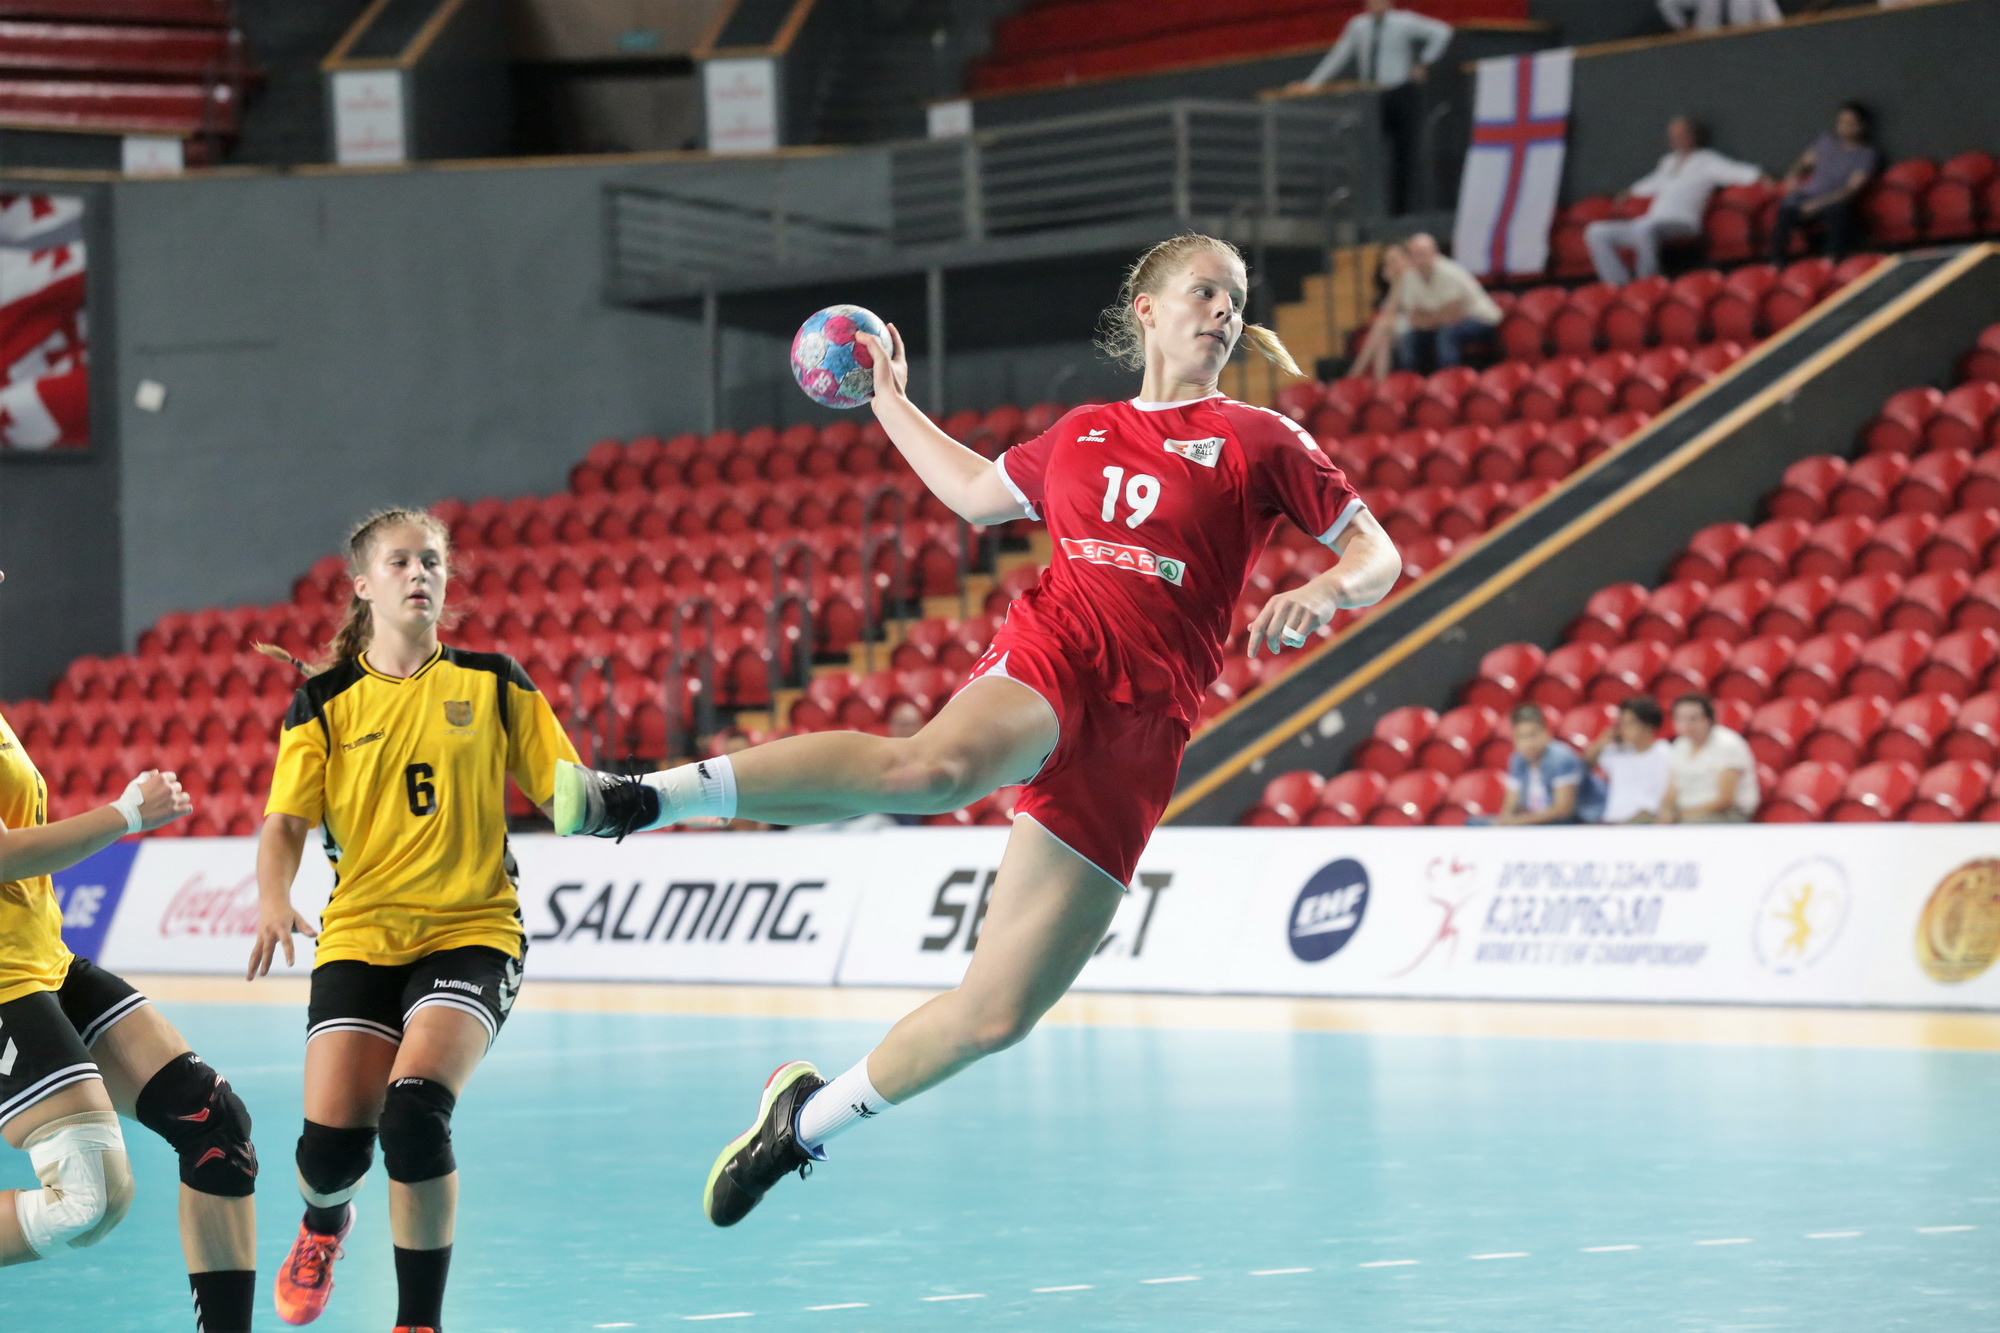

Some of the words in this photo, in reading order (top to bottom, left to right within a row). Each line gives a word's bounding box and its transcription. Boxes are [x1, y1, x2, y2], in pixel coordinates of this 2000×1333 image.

[1192, 440, 1216, 450] HAND
[1101, 465, 1161, 529] 19
[1082, 545, 1155, 569] SPAR
[405, 762, 438, 817] 6
[1296, 882, 1366, 926] EHF
[433, 978, 483, 996] hummel
